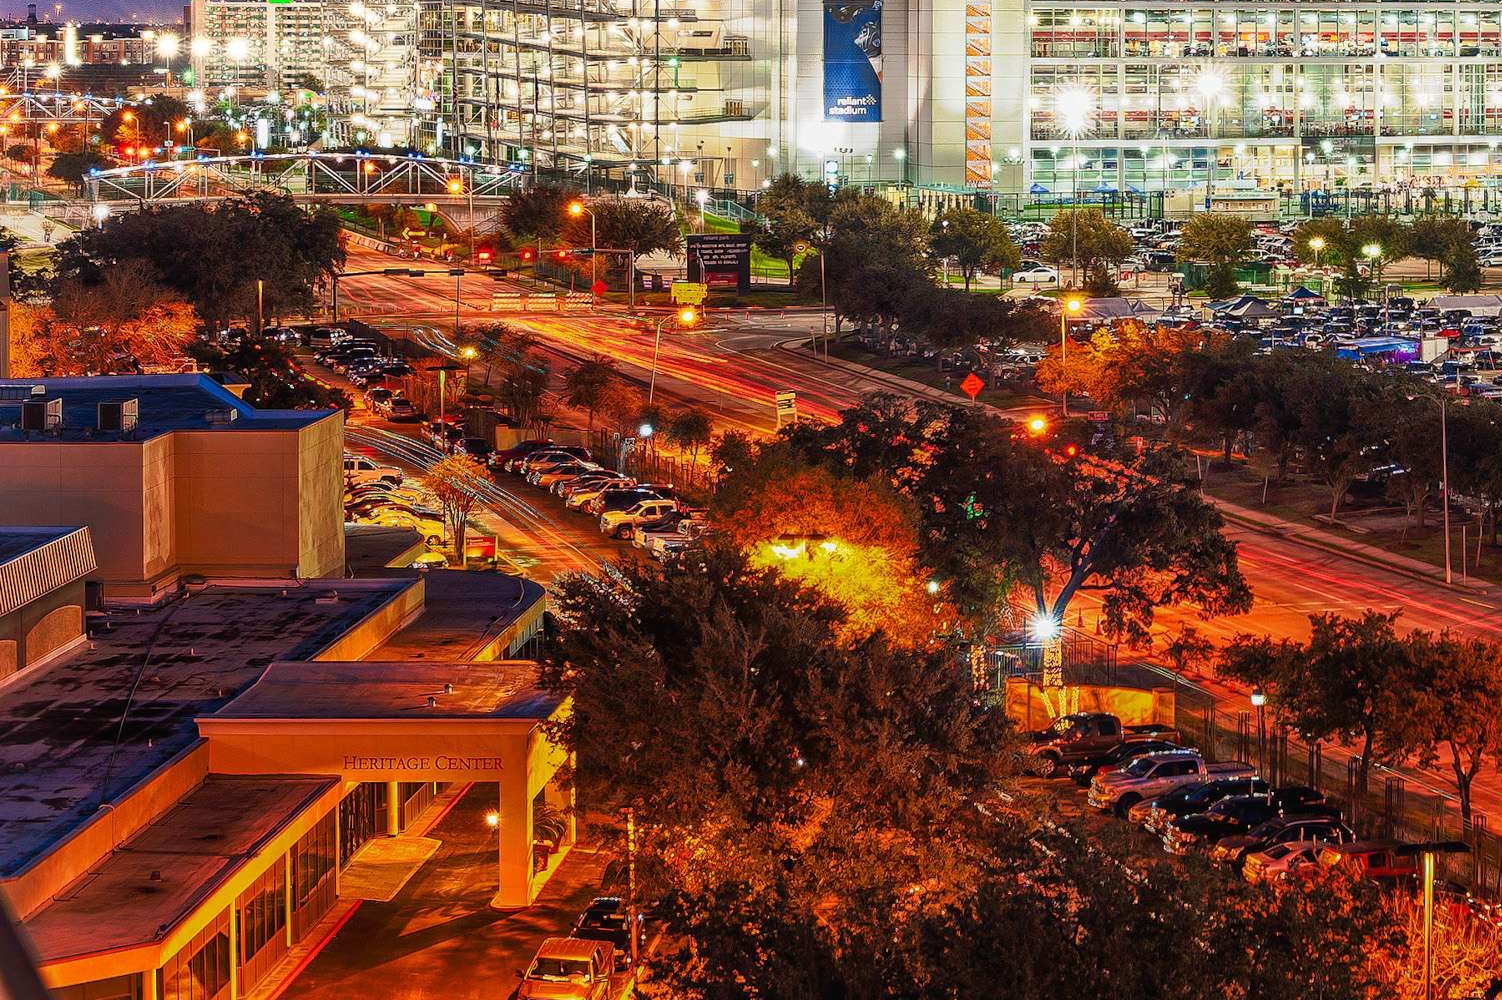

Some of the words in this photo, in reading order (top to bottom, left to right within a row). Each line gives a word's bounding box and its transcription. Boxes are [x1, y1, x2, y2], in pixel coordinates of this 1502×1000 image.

[836, 96, 867, 106] reliant
[828, 105, 868, 115] stadium
[342, 754, 431, 770] HERITAGE
[435, 754, 504, 770] CENTER
